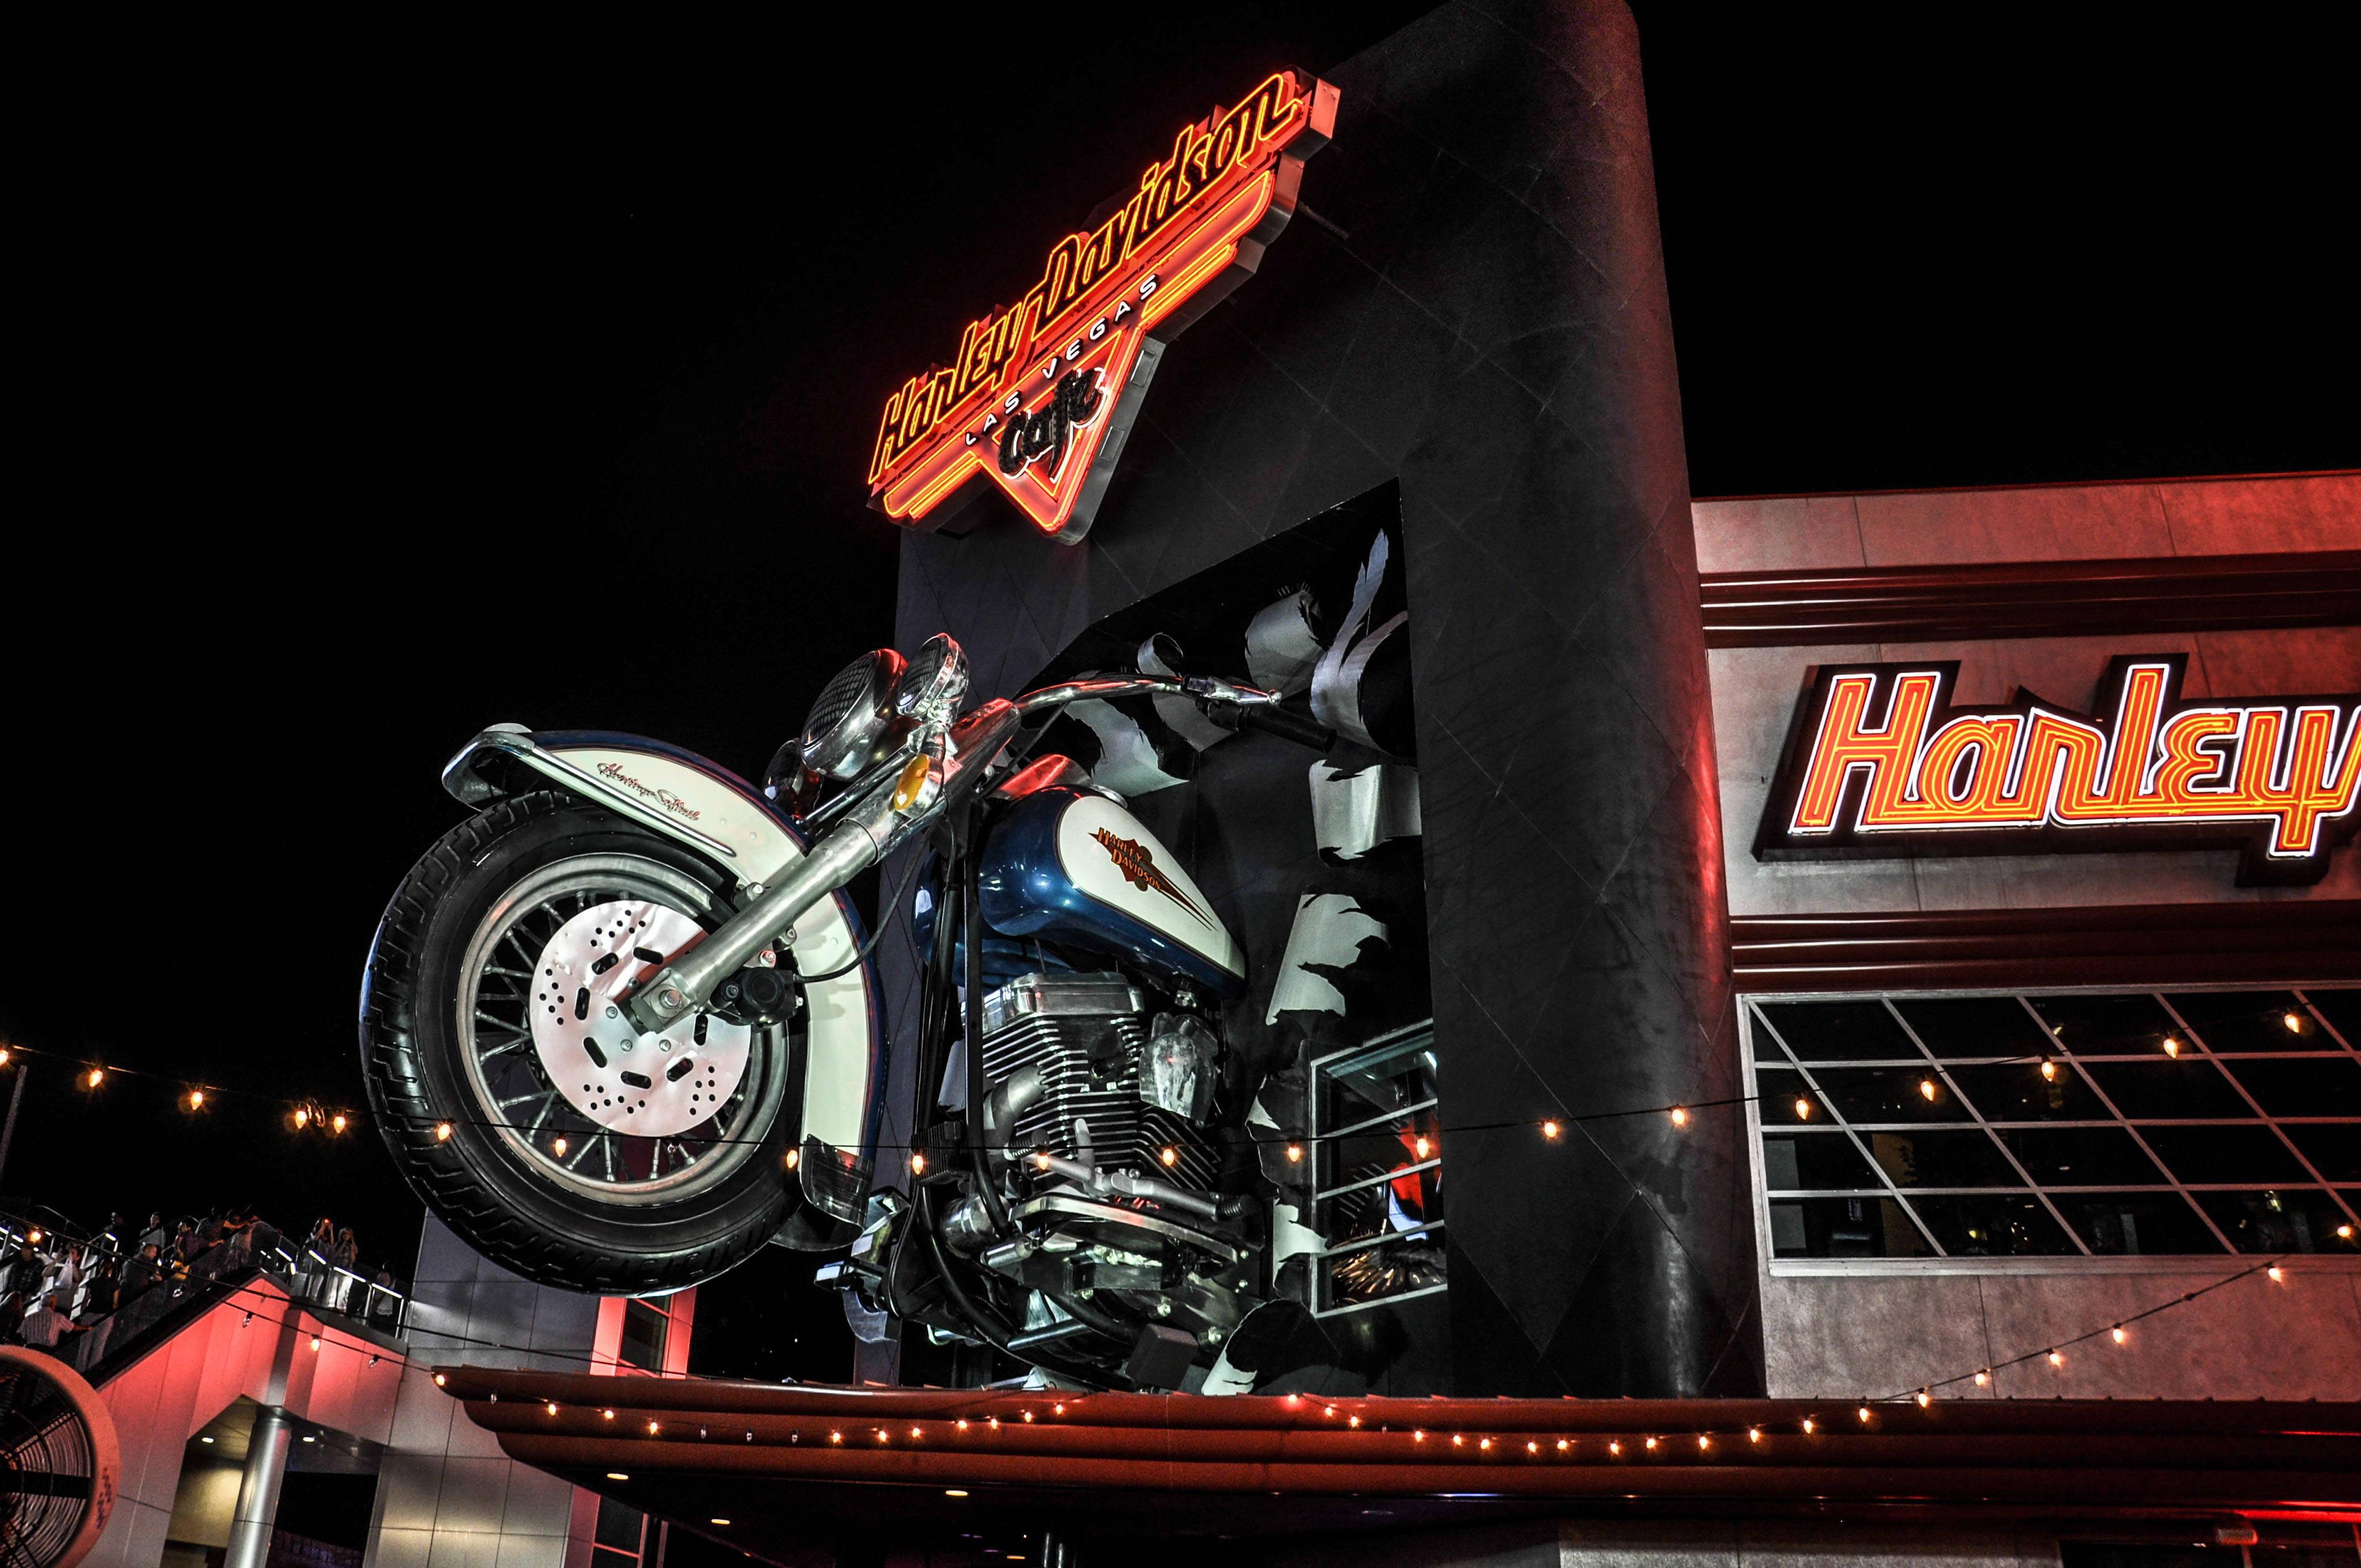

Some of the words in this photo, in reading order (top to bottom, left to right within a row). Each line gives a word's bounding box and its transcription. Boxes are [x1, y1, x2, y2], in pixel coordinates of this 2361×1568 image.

[964, 390, 1022, 446] LAS
[1041, 274, 1160, 380] VEGAS
[1787, 662, 2361, 860] Harley
[1112, 848, 1161, 891] DAVIDSON
